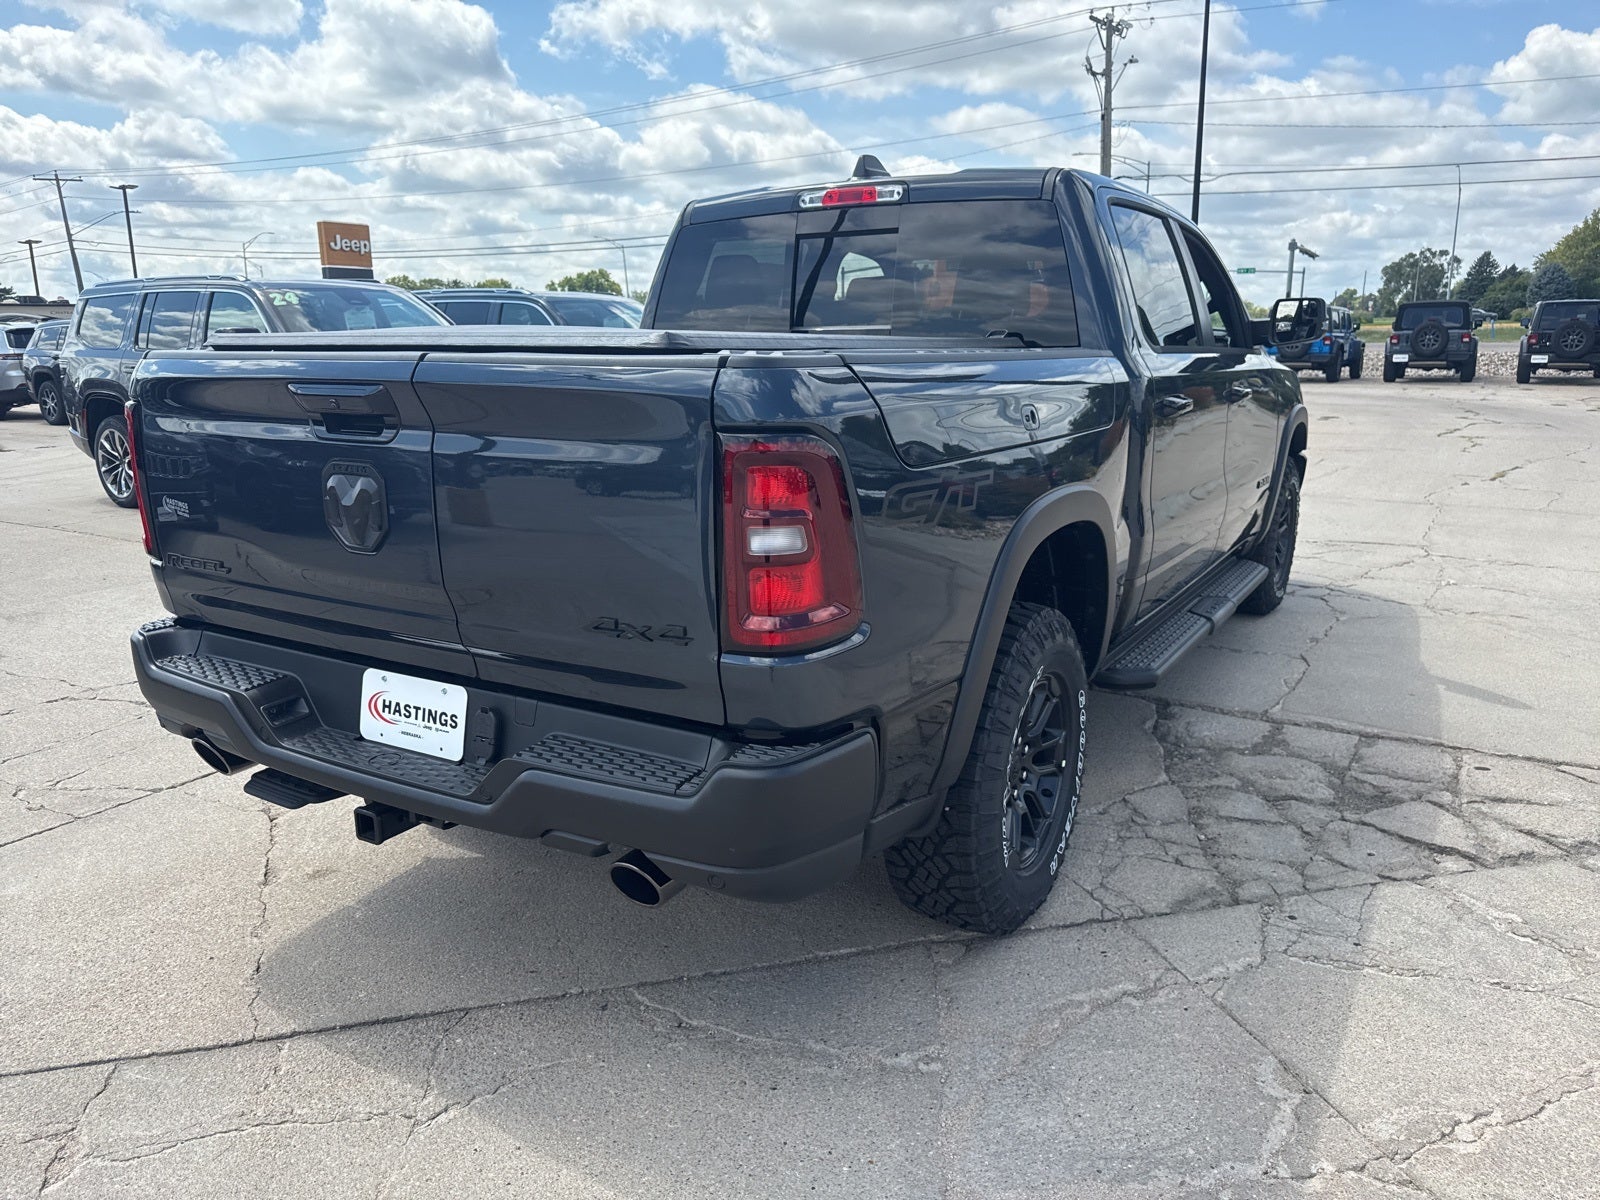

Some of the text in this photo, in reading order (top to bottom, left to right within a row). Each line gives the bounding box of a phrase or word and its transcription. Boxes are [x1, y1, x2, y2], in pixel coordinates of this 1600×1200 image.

[329, 233, 370, 256] Jeep
[167, 552, 232, 574] REBEL
[381, 698, 459, 729] HASTINGS
[1050, 689, 1087, 876] GOODYEAR
